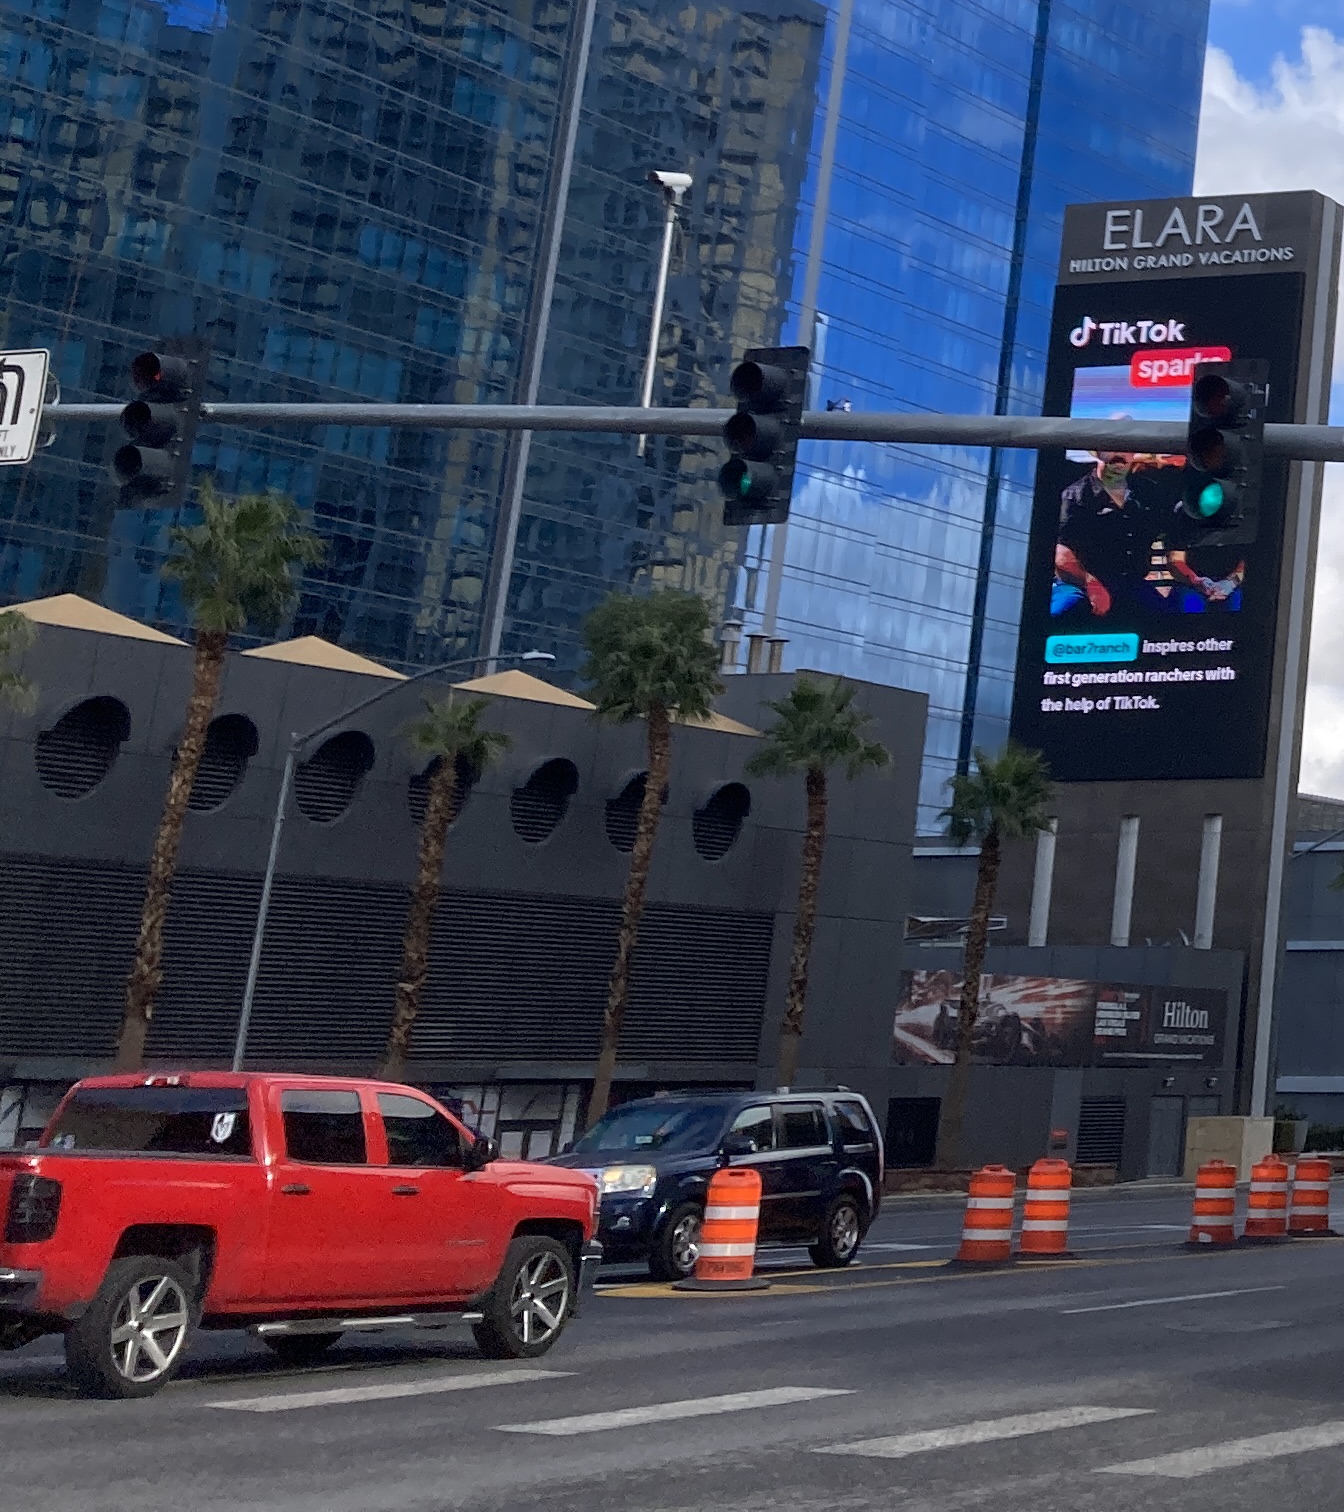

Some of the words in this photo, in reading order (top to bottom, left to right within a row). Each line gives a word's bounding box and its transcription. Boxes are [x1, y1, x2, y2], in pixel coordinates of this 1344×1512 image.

[1103, 202, 1262, 251] ELARA
[1069, 256, 1129, 273] HILTON
[1133, 252, 1194, 270] GRAND
[1198, 246, 1295, 266] VACATIONS
[1099, 319, 1186, 346] TikTok
[1142, 639, 1196, 656] inspires
[1196, 638, 1234, 652] other
[1043, 671, 1072, 686] first
[1072, 670, 1143, 688] generation
[1144, 668, 1204, 683] ranchers
[1205, 666, 1236, 681] with
[1040, 698, 1064, 712] the
[1065, 697, 1094, 714] help
[1096, 696, 1112, 710] of
[1163, 1001, 1209, 1029] Hilton
